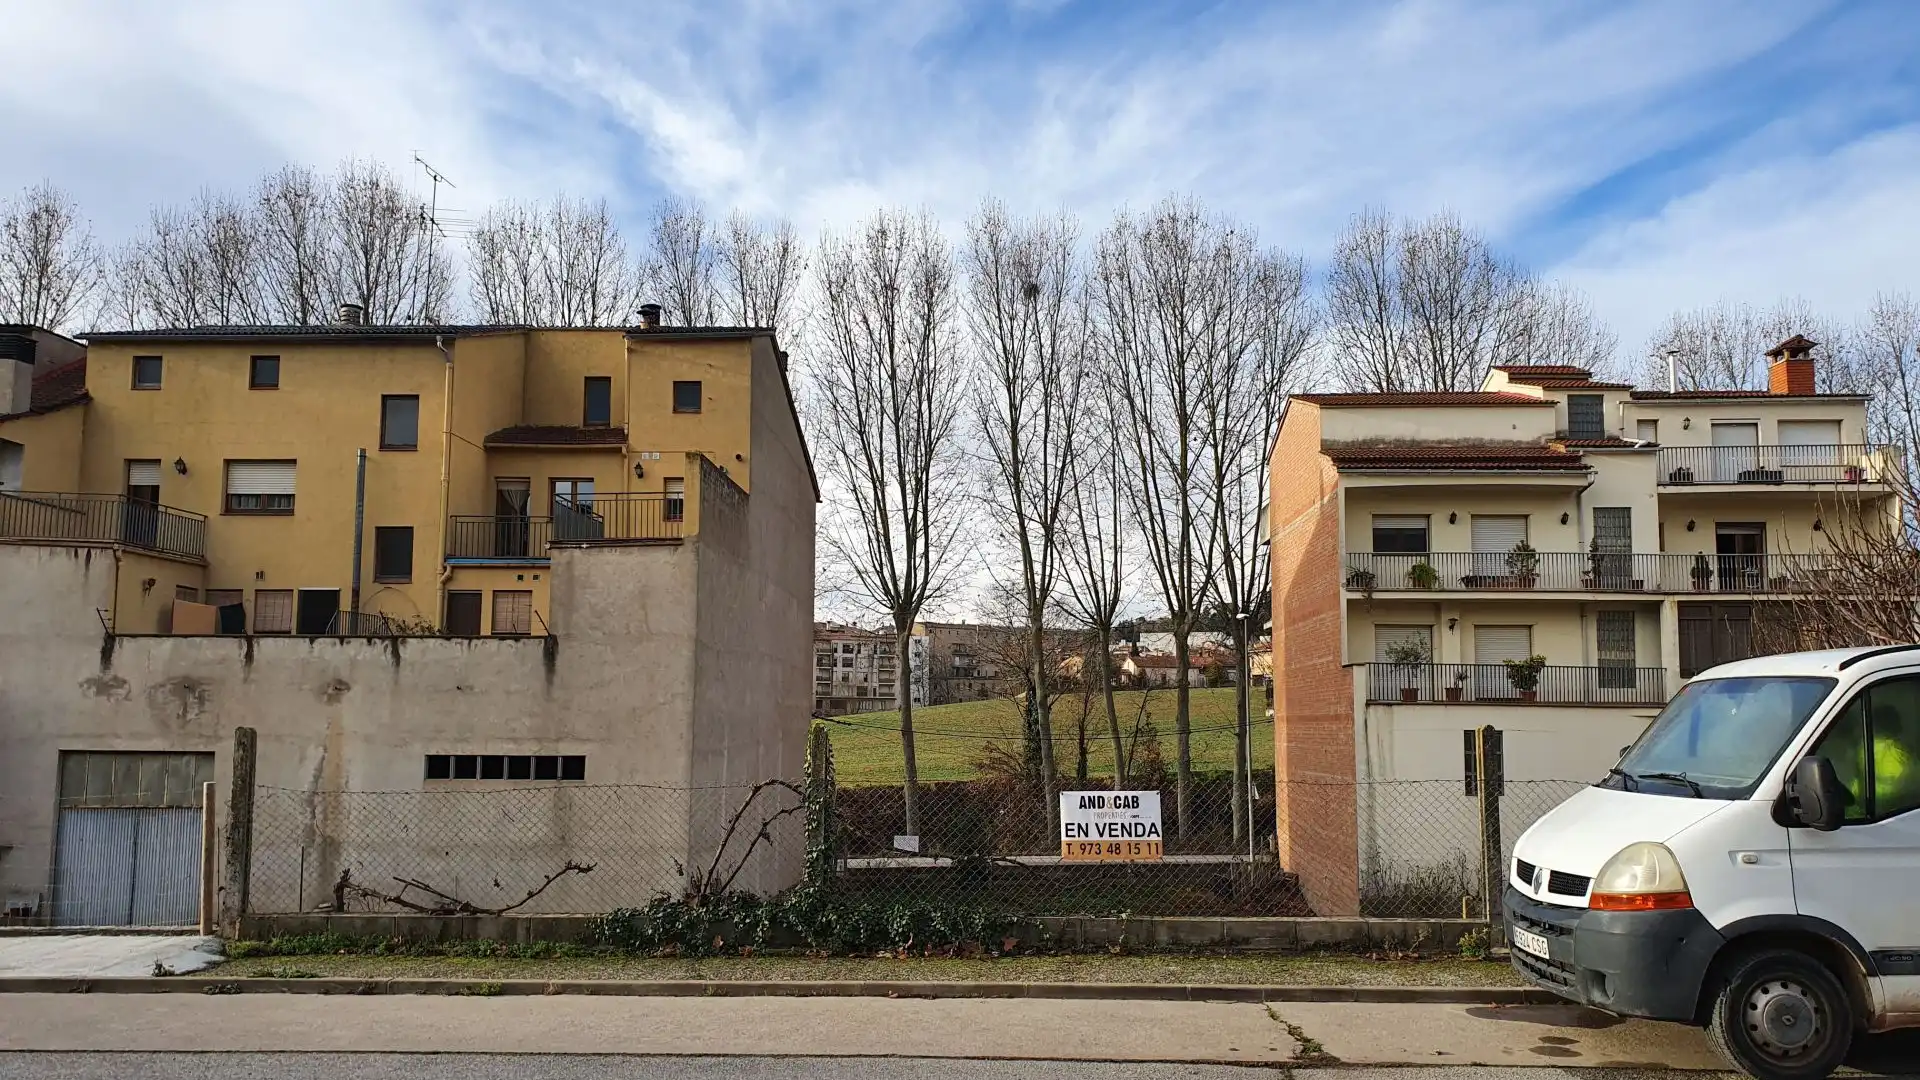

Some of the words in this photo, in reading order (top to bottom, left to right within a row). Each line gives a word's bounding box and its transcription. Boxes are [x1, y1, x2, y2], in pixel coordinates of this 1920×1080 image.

[1079, 795, 1140, 809] AND&CAB
[1065, 822, 1089, 838] EN
[1095, 822, 1161, 838] VENDA
[1066, 843, 1075, 855] T.
[1080, 843, 1102, 855] 973
[1107, 843, 1121, 855] 48
[1127, 843, 1141, 855] 15
[1147, 843, 1159, 855] 11
